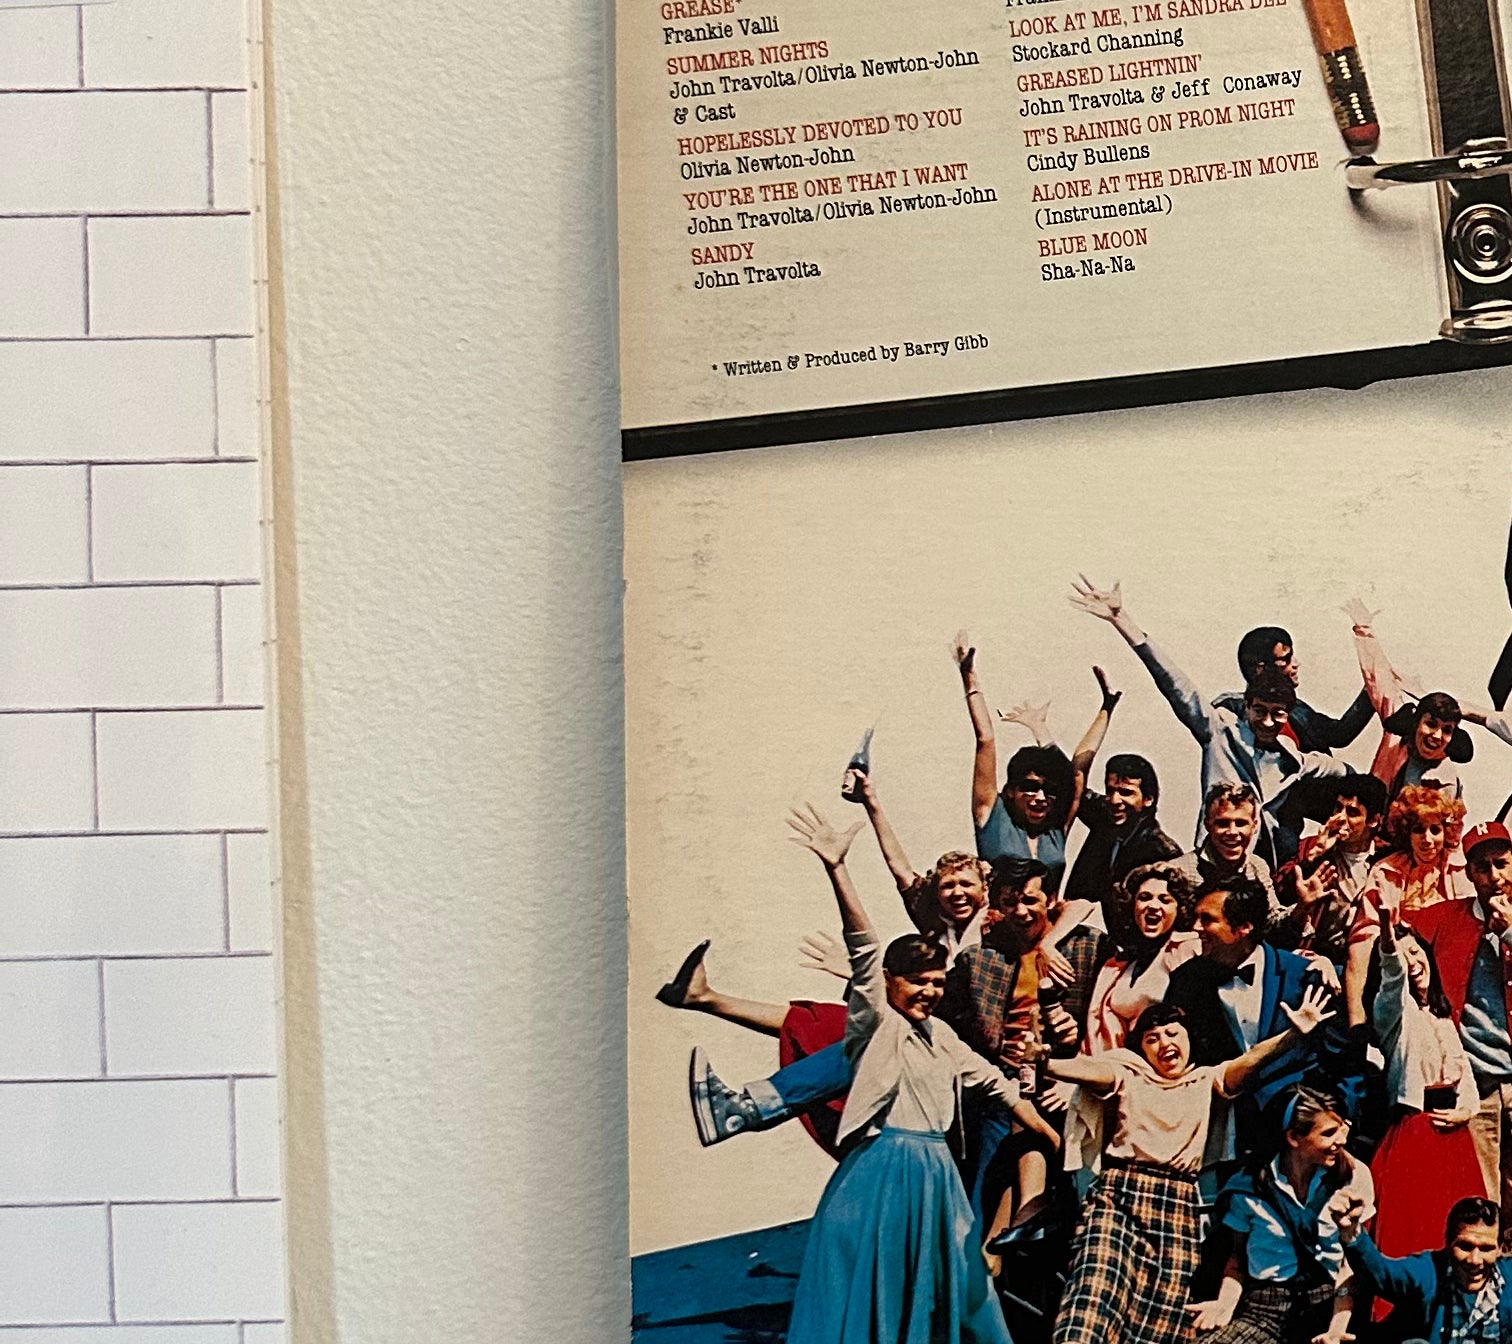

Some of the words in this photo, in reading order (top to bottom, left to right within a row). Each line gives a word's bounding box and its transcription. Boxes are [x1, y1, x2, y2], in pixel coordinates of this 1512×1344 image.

[662, 22, 733, 44] Frankie
[737, 16, 779, 36] Valli
[1009, 16, 1059, 38] LOOK
[1064, 12, 1086, 32] AT
[666, 50, 754, 75] SUMMER
[758, 40, 828, 64] NIGHTS
[1012, 37, 1092, 62] Stockard
[1097, 28, 1184, 52] Channing
[670, 80, 716, 99] John
[860, 49, 980, 77] Newton-John
[1017, 66, 1103, 92] GREASED
[1020, 98, 1065, 117] John
[1068, 88, 1144, 111] Travolta
[1151, 86, 1165, 103] &
[1172, 78, 1210, 99] Jeff
[1223, 70, 1302, 93] Conaway
[673, 107, 688, 125] &
[695, 103, 736, 122] Cast
[677, 126, 796, 156] HOPELESSLY
[801, 116, 890, 142] DEVOTED
[894, 113, 918, 134] TO
[922, 108, 962, 128] YOU
[680, 160, 732, 180] Olivia
[736, 146, 856, 174] Newton-John
[1032, 179, 1092, 202] ALONE
[1098, 176, 1120, 194] AT
[1125, 170, 1164, 191] THE
[1168, 160, 1252, 186] DRIVE-IN
[1257, 152, 1318, 175] MOVIE
[1036, 194, 1172, 230] (Instrumental)
[691, 242, 754, 265] SANDY
[1038, 236, 1087, 257] BLUE
[1092, 228, 1147, 251] MOON
[694, 270, 740, 289] John
[743, 262, 821, 284] Travolta
[1041, 256, 1135, 281] Sha-Na-Na
[723, 360, 782, 376] Written
[787, 355, 800, 370] &
[804, 346, 878, 368] Produced
[880, 345, 900, 362] by
[903, 341, 950, 357] Barry
[954, 334, 988, 351] Gibb
